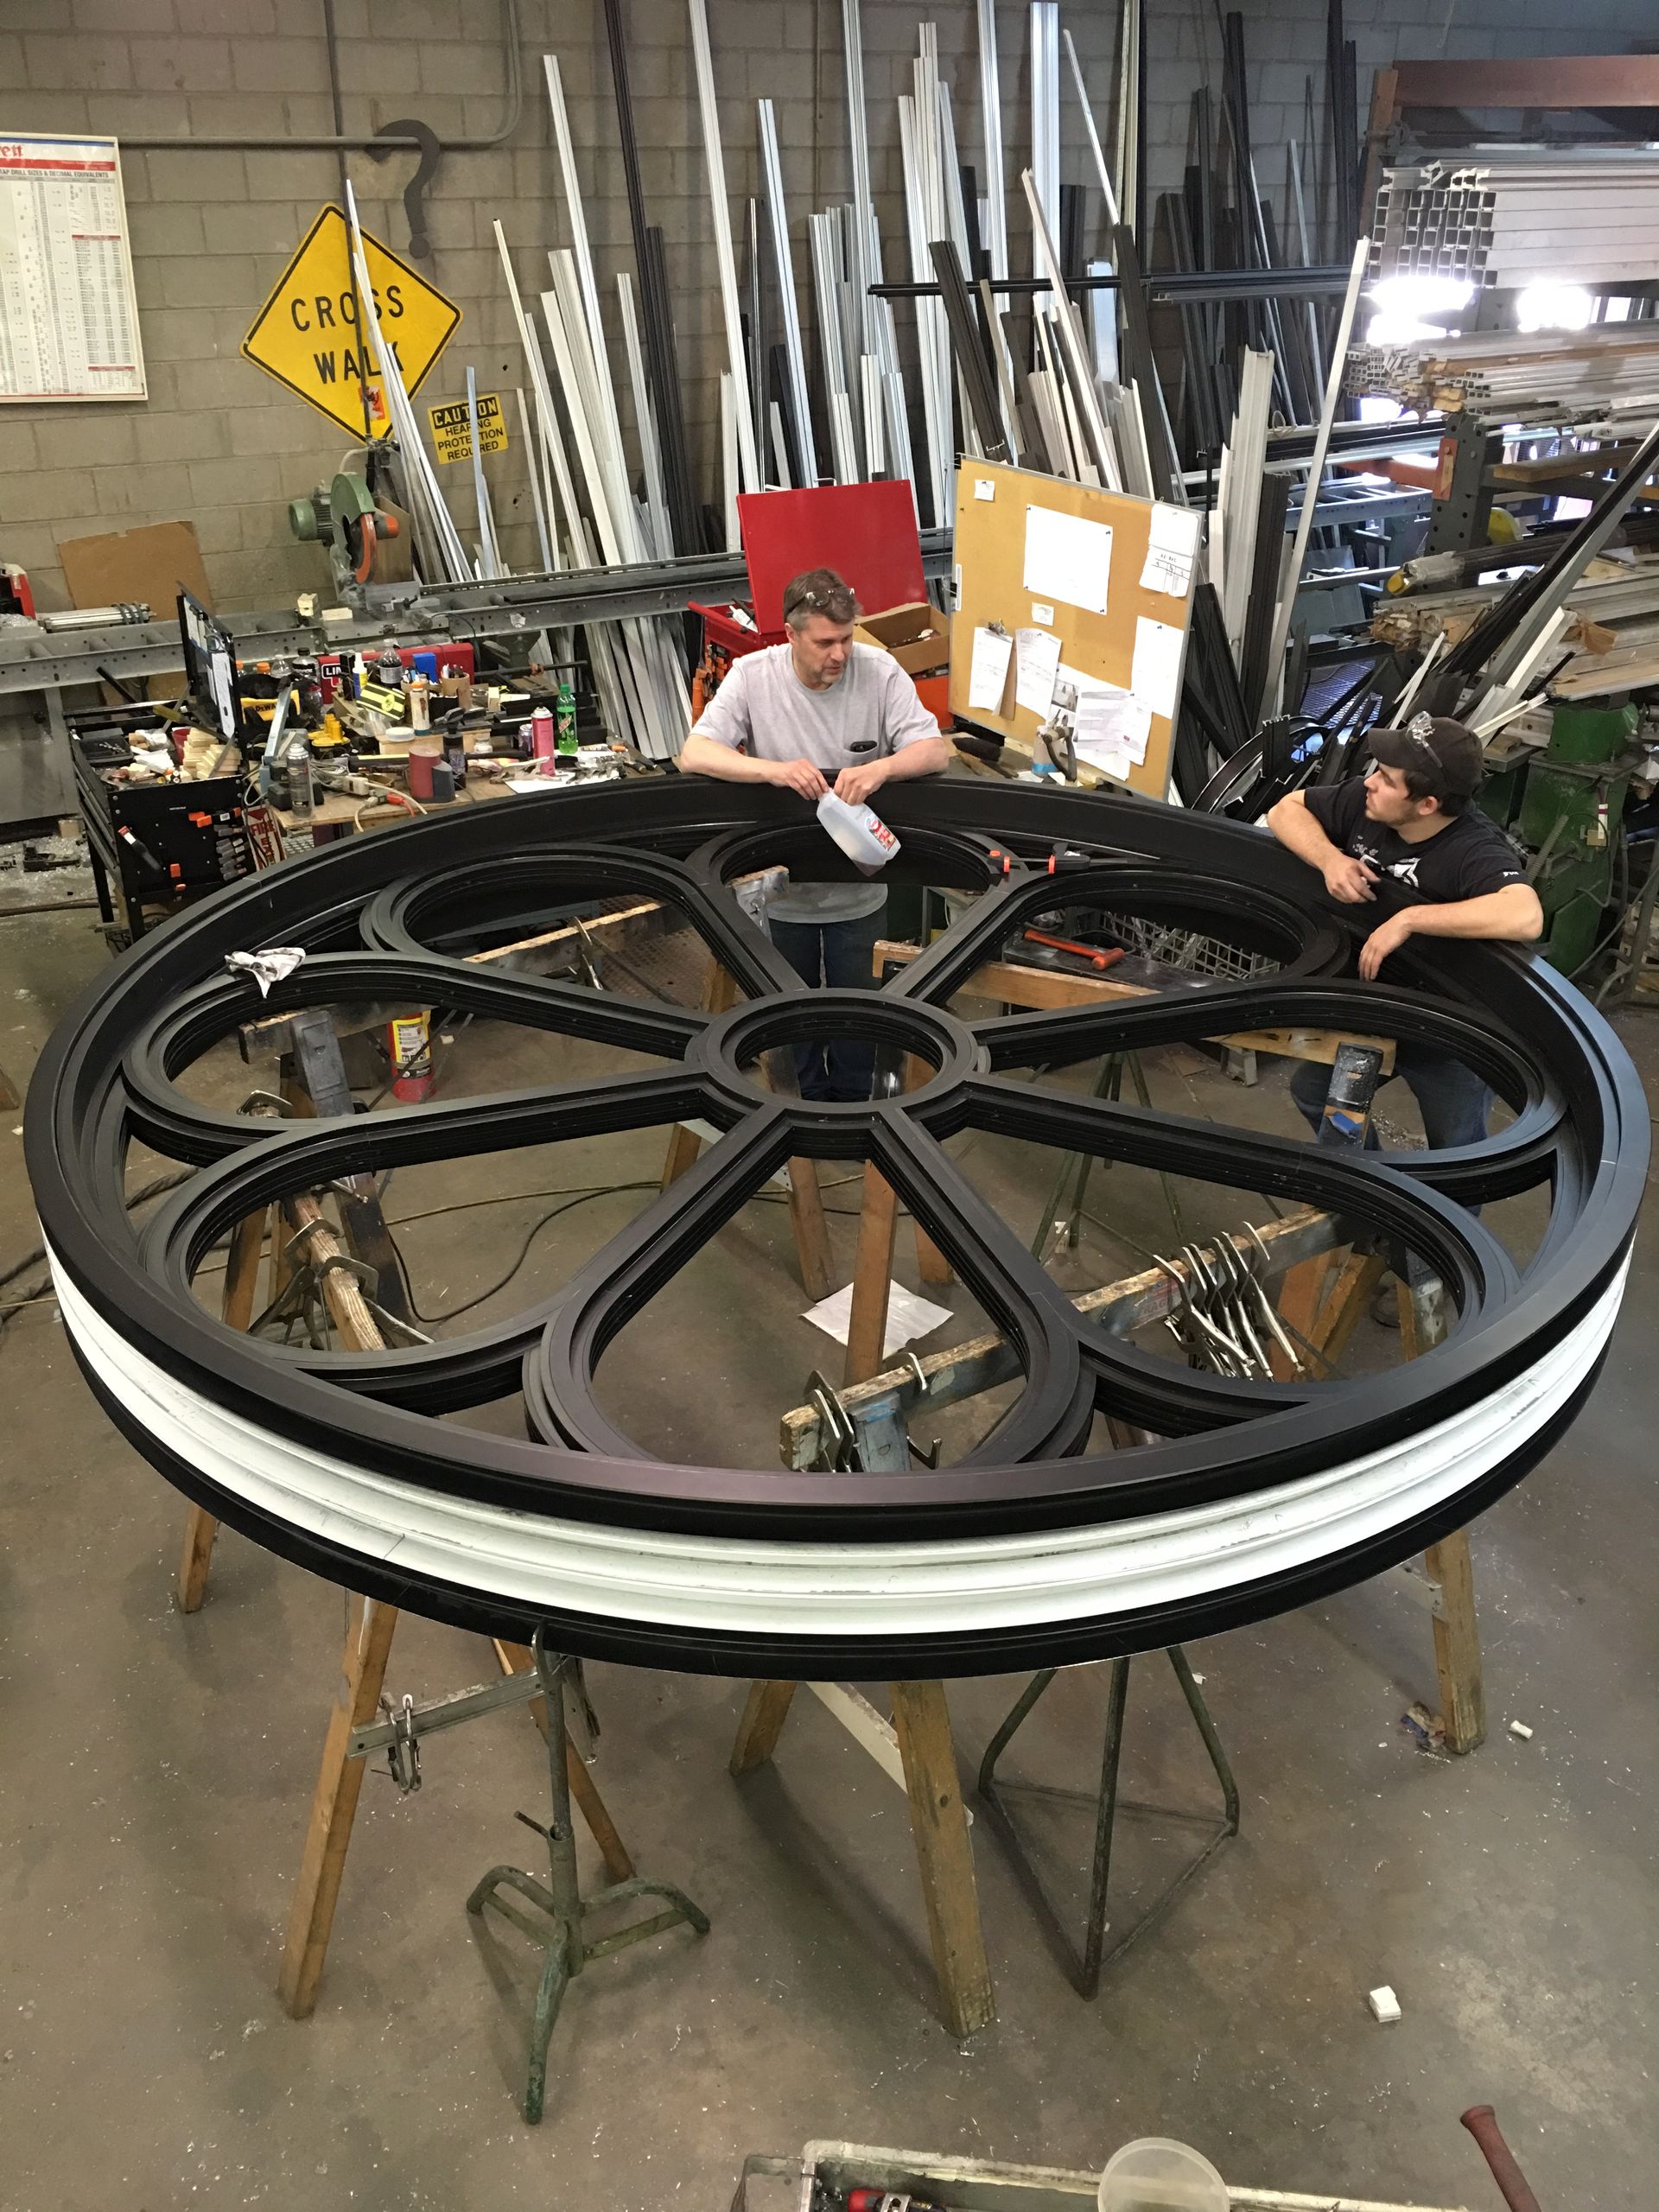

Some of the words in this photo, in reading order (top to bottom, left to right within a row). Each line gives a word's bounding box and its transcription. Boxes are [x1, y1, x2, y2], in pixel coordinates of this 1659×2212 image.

[0, 144, 22, 157] ett
[434, 399, 497, 426] CAUTON
[446, 418, 491, 437] HEARNG
[438, 428, 504, 450] PROTETION
[448, 441, 499, 461] REQURED
